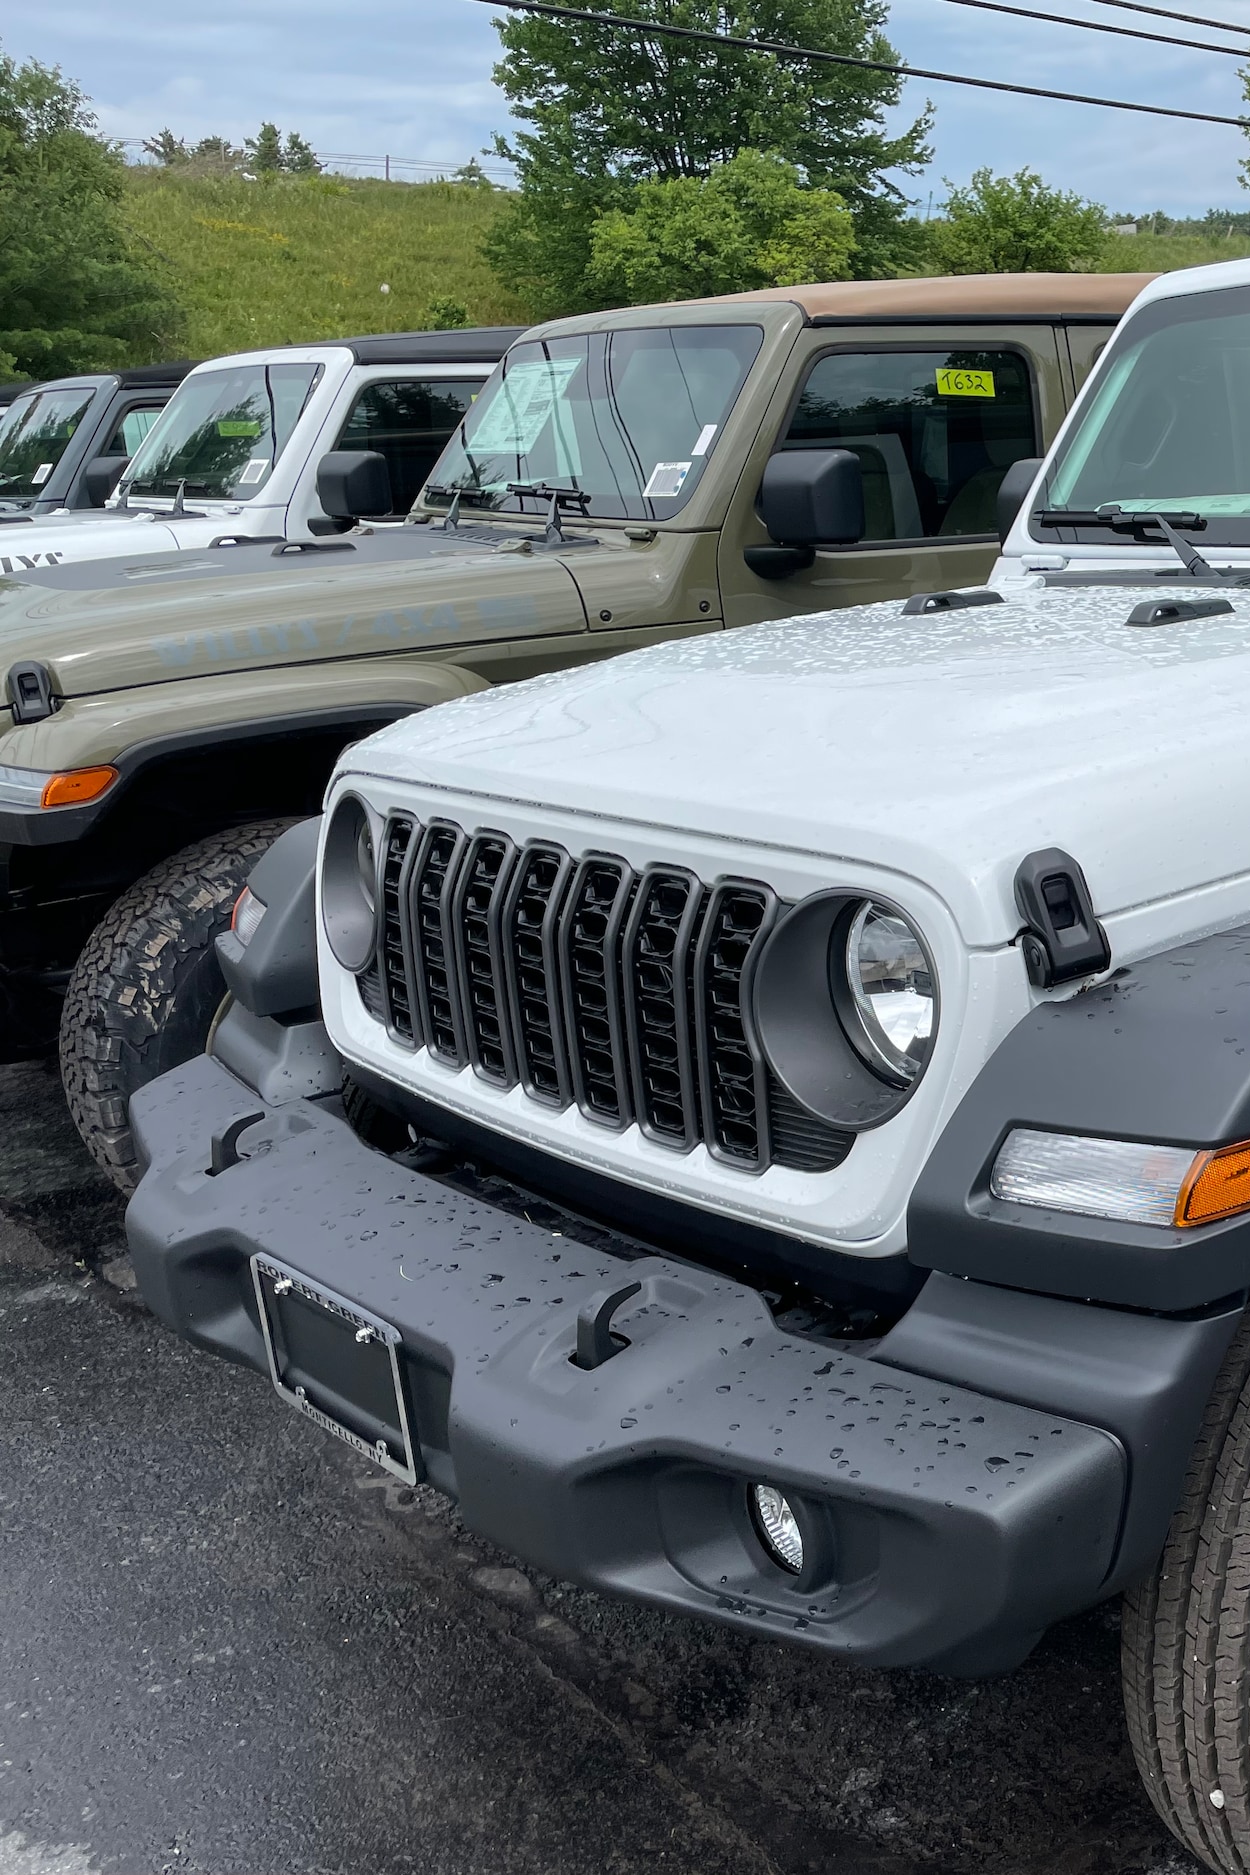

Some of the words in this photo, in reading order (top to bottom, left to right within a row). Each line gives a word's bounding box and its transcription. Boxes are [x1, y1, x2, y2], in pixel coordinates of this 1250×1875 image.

[941, 371, 988, 392] T632
[301, 1402, 362, 1451] MONTICELLO
[368, 1447, 382, 1463] NY
